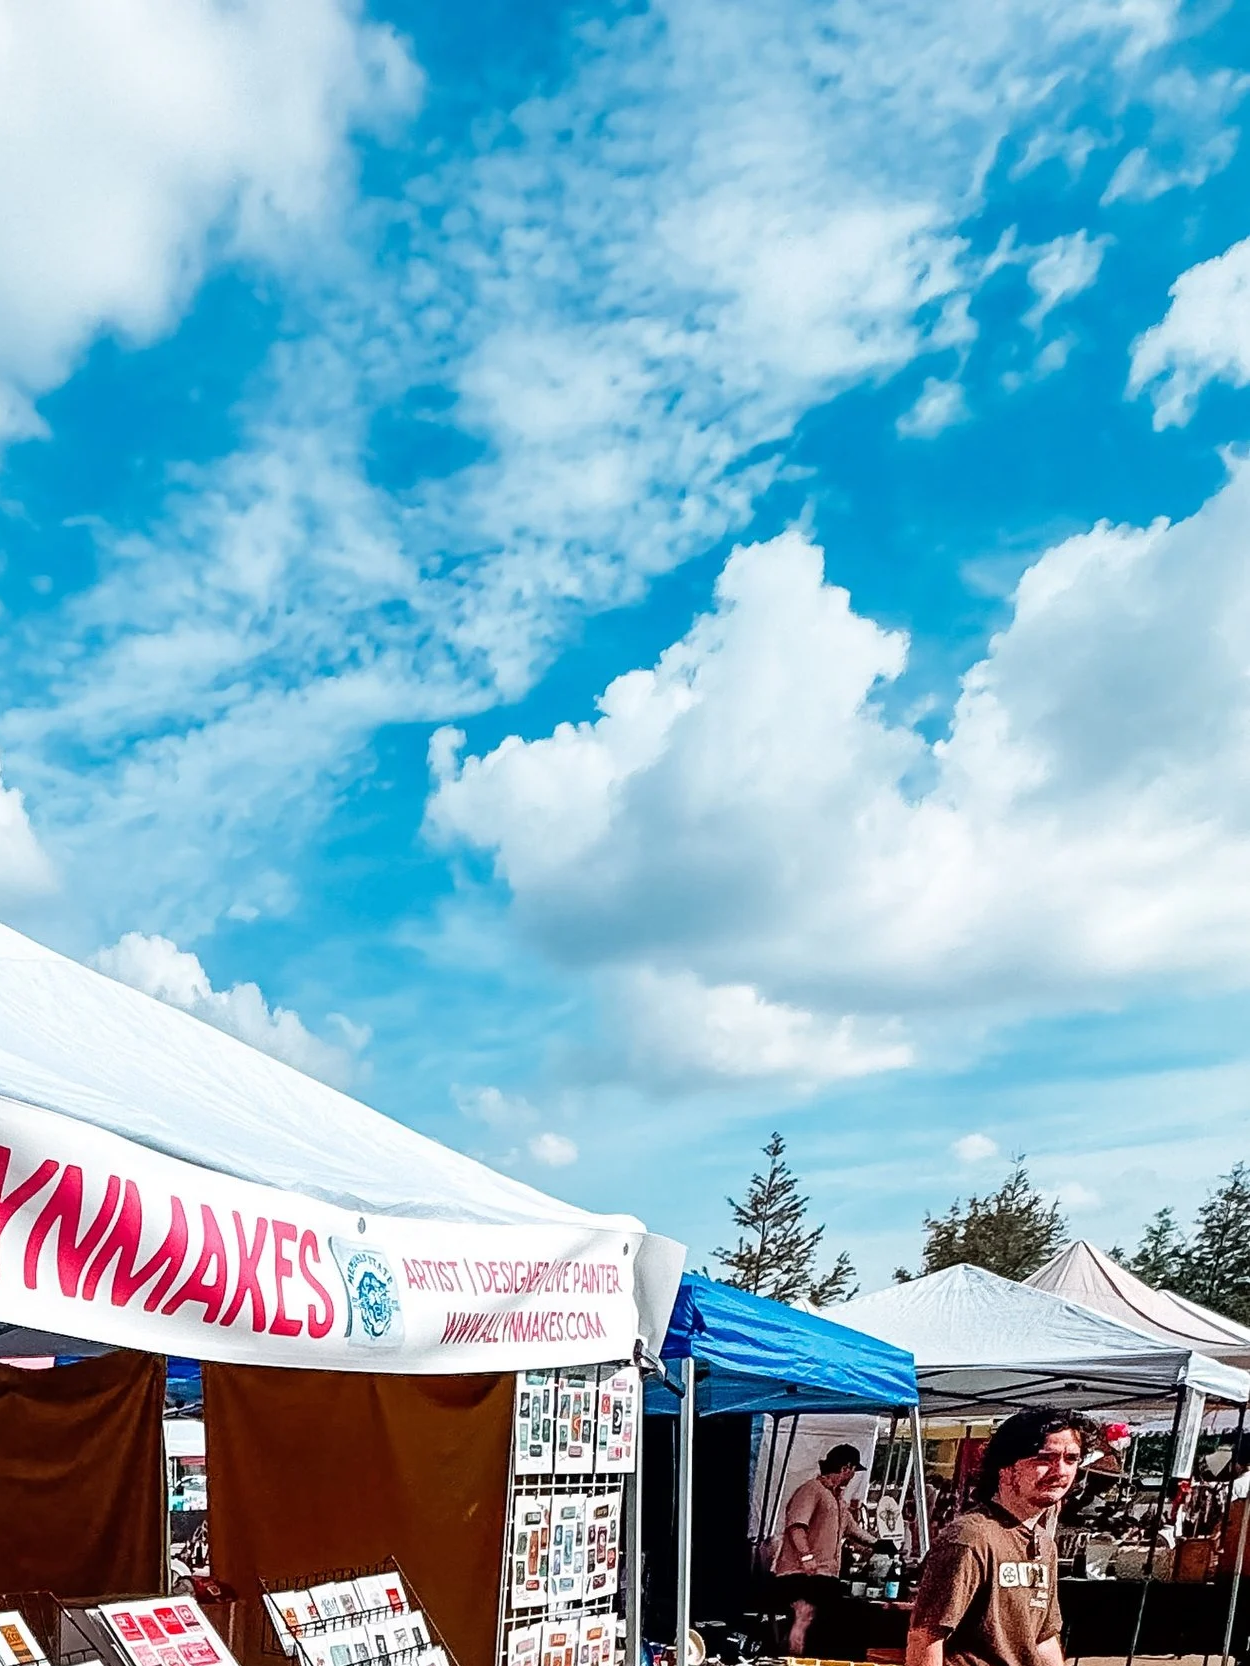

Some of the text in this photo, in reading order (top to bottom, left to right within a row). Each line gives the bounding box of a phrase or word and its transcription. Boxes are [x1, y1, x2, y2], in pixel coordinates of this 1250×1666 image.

[402, 1258, 464, 1293] ARTIST
[573, 1263, 623, 1294] PAINTER
[440, 1311, 607, 1345] WWW.ALLYNMAKES.COM
